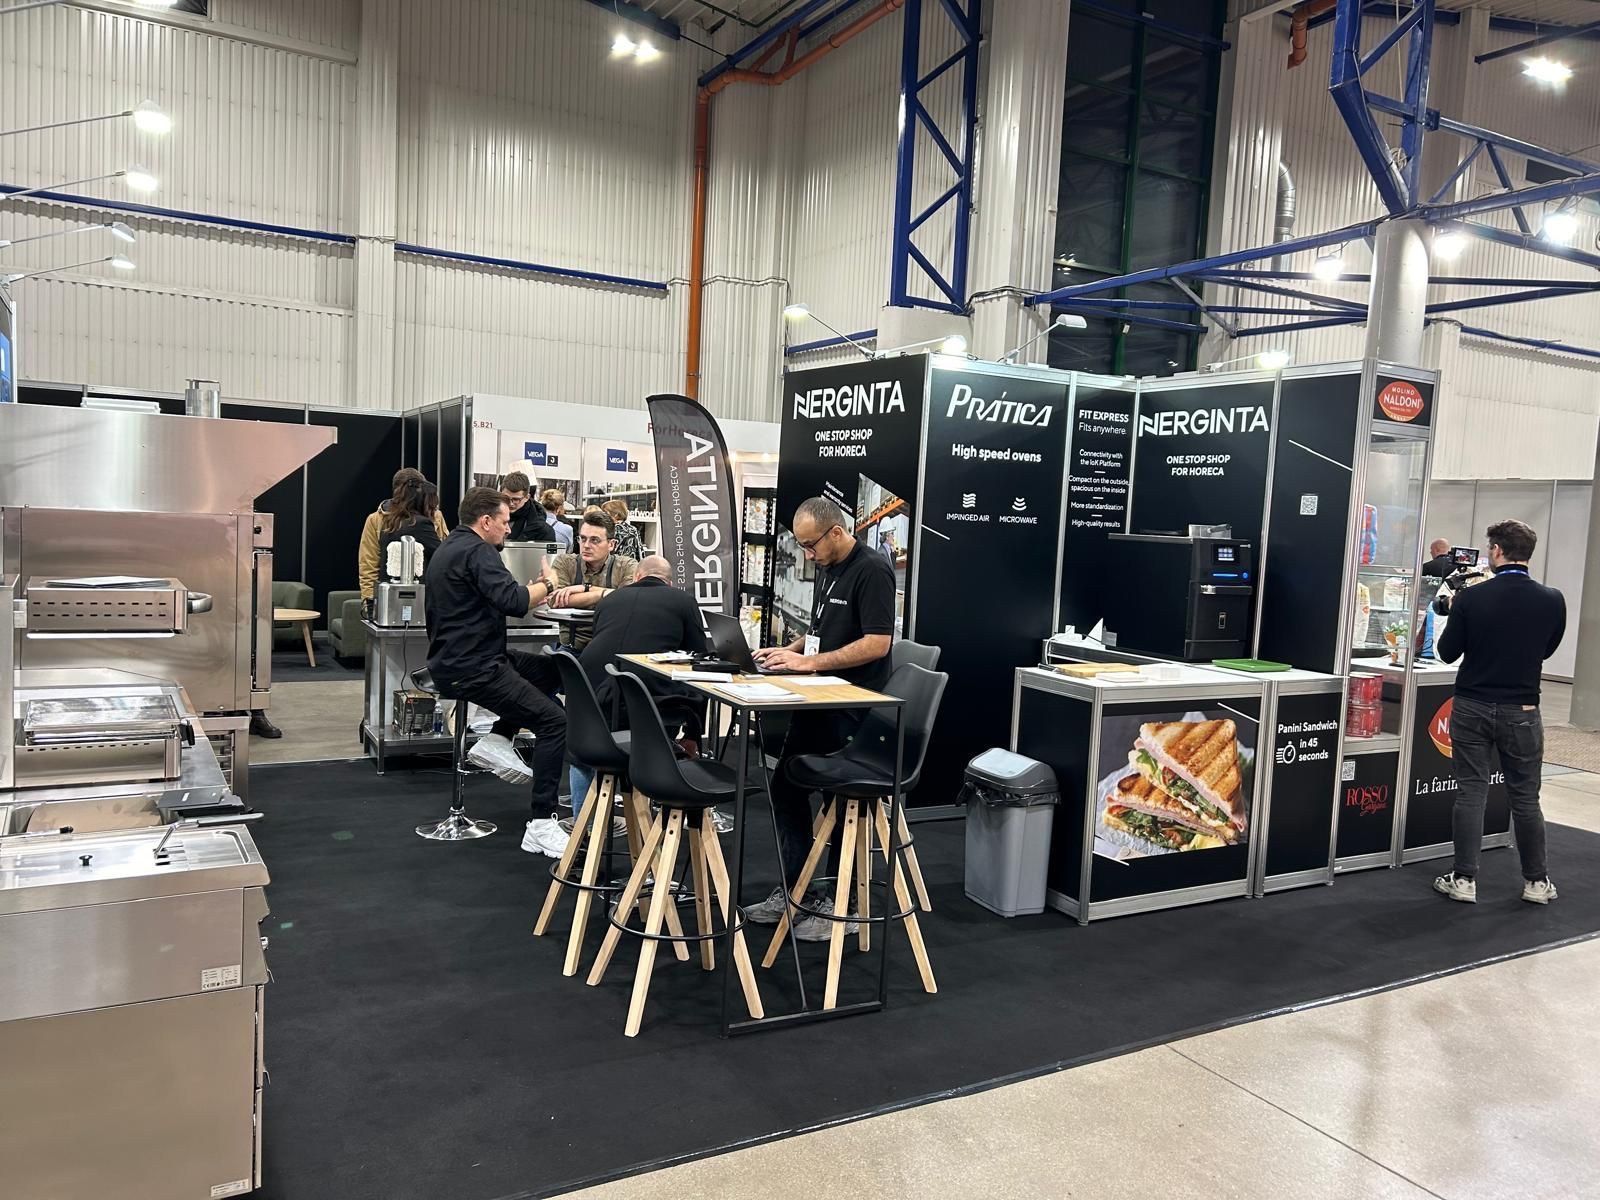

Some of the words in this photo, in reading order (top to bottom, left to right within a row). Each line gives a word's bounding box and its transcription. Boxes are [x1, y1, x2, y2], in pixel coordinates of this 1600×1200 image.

[1391, 386, 1415, 396] MOLINO
[793, 380, 905, 420] NERGINTA
[1383, 393, 1420, 409] NALDONI
[1079, 409, 1092, 419] FIT
[1093, 411, 1129, 422] EXPRESS
[1079, 421, 1091, 431] Fits
[1138, 406, 1269, 437] NERGINTA
[815, 431, 830, 441] ONE
[831, 430, 850, 441] STOP
[851, 429, 873, 440] SHOP
[819, 446, 834, 457] FOR
[835, 445, 867, 457] HORECA
[952, 443, 977, 459] High
[979, 448, 1010, 461] speed
[1012, 452, 1042, 462] ovens
[1079, 449, 1112, 459] Connectivity
[1166, 455, 1184, 465] ONE
[1185, 455, 1206, 464] STOP
[1206, 454, 1231, 464] SHOP
[1171, 467, 1188, 476] FOR
[1189, 466, 1224, 476] HORECA
[1068, 475, 1092, 484] Compact
[1071, 501, 1085, 509] More
[946, 513, 978, 521] IMPINGED
[979, 514, 990, 522] AIR
[999, 516, 1038, 524] MICROWAVE
[1072, 519, 1103, 528] High-quality
[1278, 722, 1302, 734] Panini
[1303, 719, 1338, 732] Sandwich
[1299, 738, 1307, 748] in
[1308, 737, 1318, 748] 45
[1298, 749, 1329, 761] seconds
[1415, 779, 1428, 795] La
[1431, 774, 1458, 793] farin
[1488, 770, 1505, 785] rte
[1345, 784, 1389, 806] ROSSO
